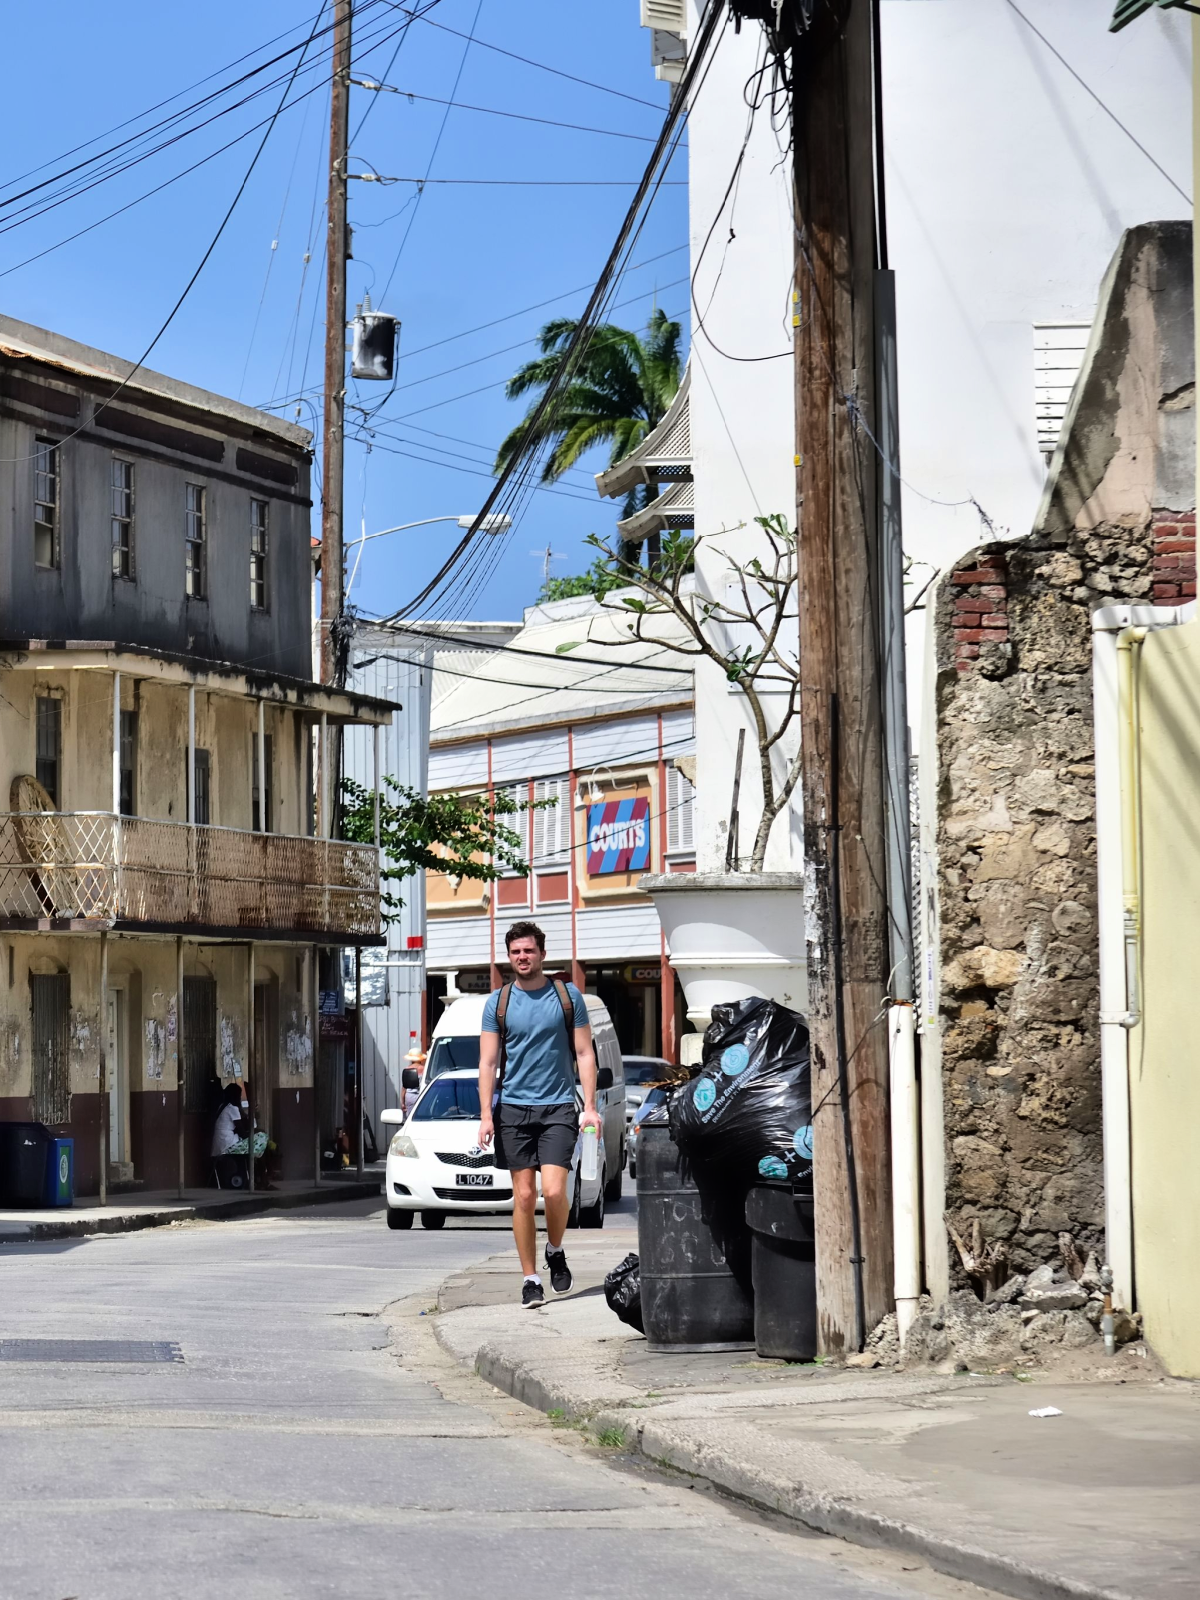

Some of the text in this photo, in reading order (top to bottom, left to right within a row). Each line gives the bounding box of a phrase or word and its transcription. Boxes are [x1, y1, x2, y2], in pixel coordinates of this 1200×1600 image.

[590, 818, 646, 853] COURTS
[635, 968, 662, 979] COU
[701, 1107, 717, 1124] Save
[713, 1095, 726, 1108] The
[723, 1059, 762, 1097] Environment
[458, 1174, 491, 1186] L 1047
